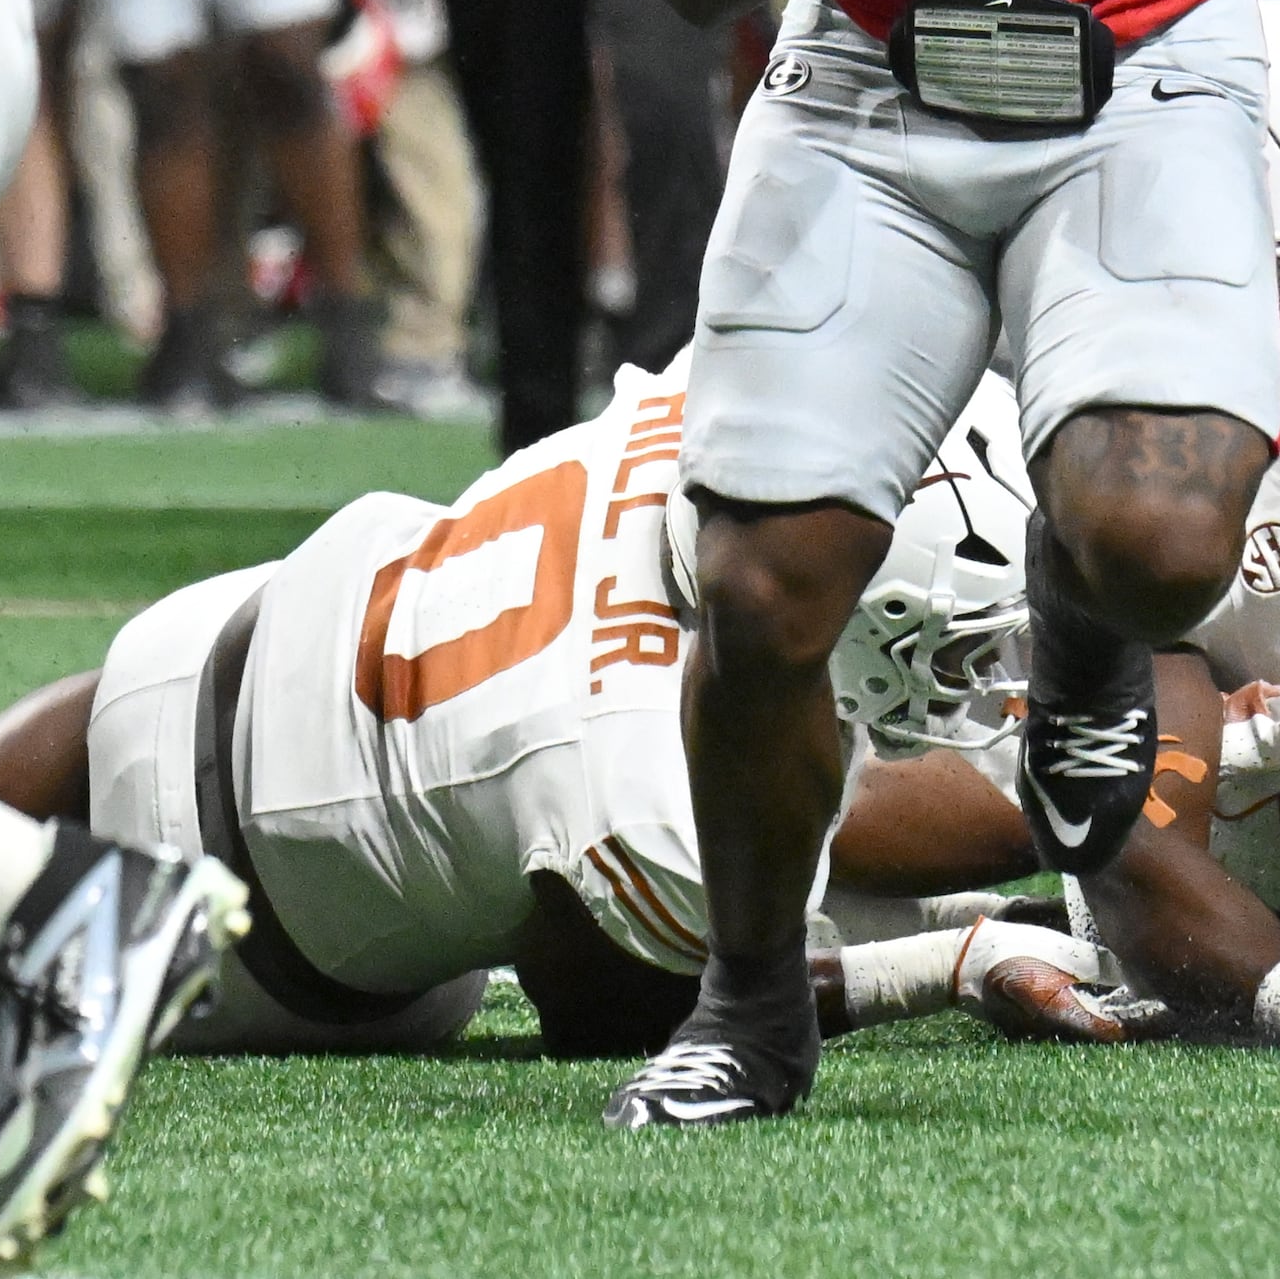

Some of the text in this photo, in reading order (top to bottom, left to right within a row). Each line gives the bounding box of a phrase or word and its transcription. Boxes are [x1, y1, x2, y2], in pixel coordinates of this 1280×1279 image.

[353, 459, 590, 723] 0
[589, 391, 687, 697] HILL JR.
